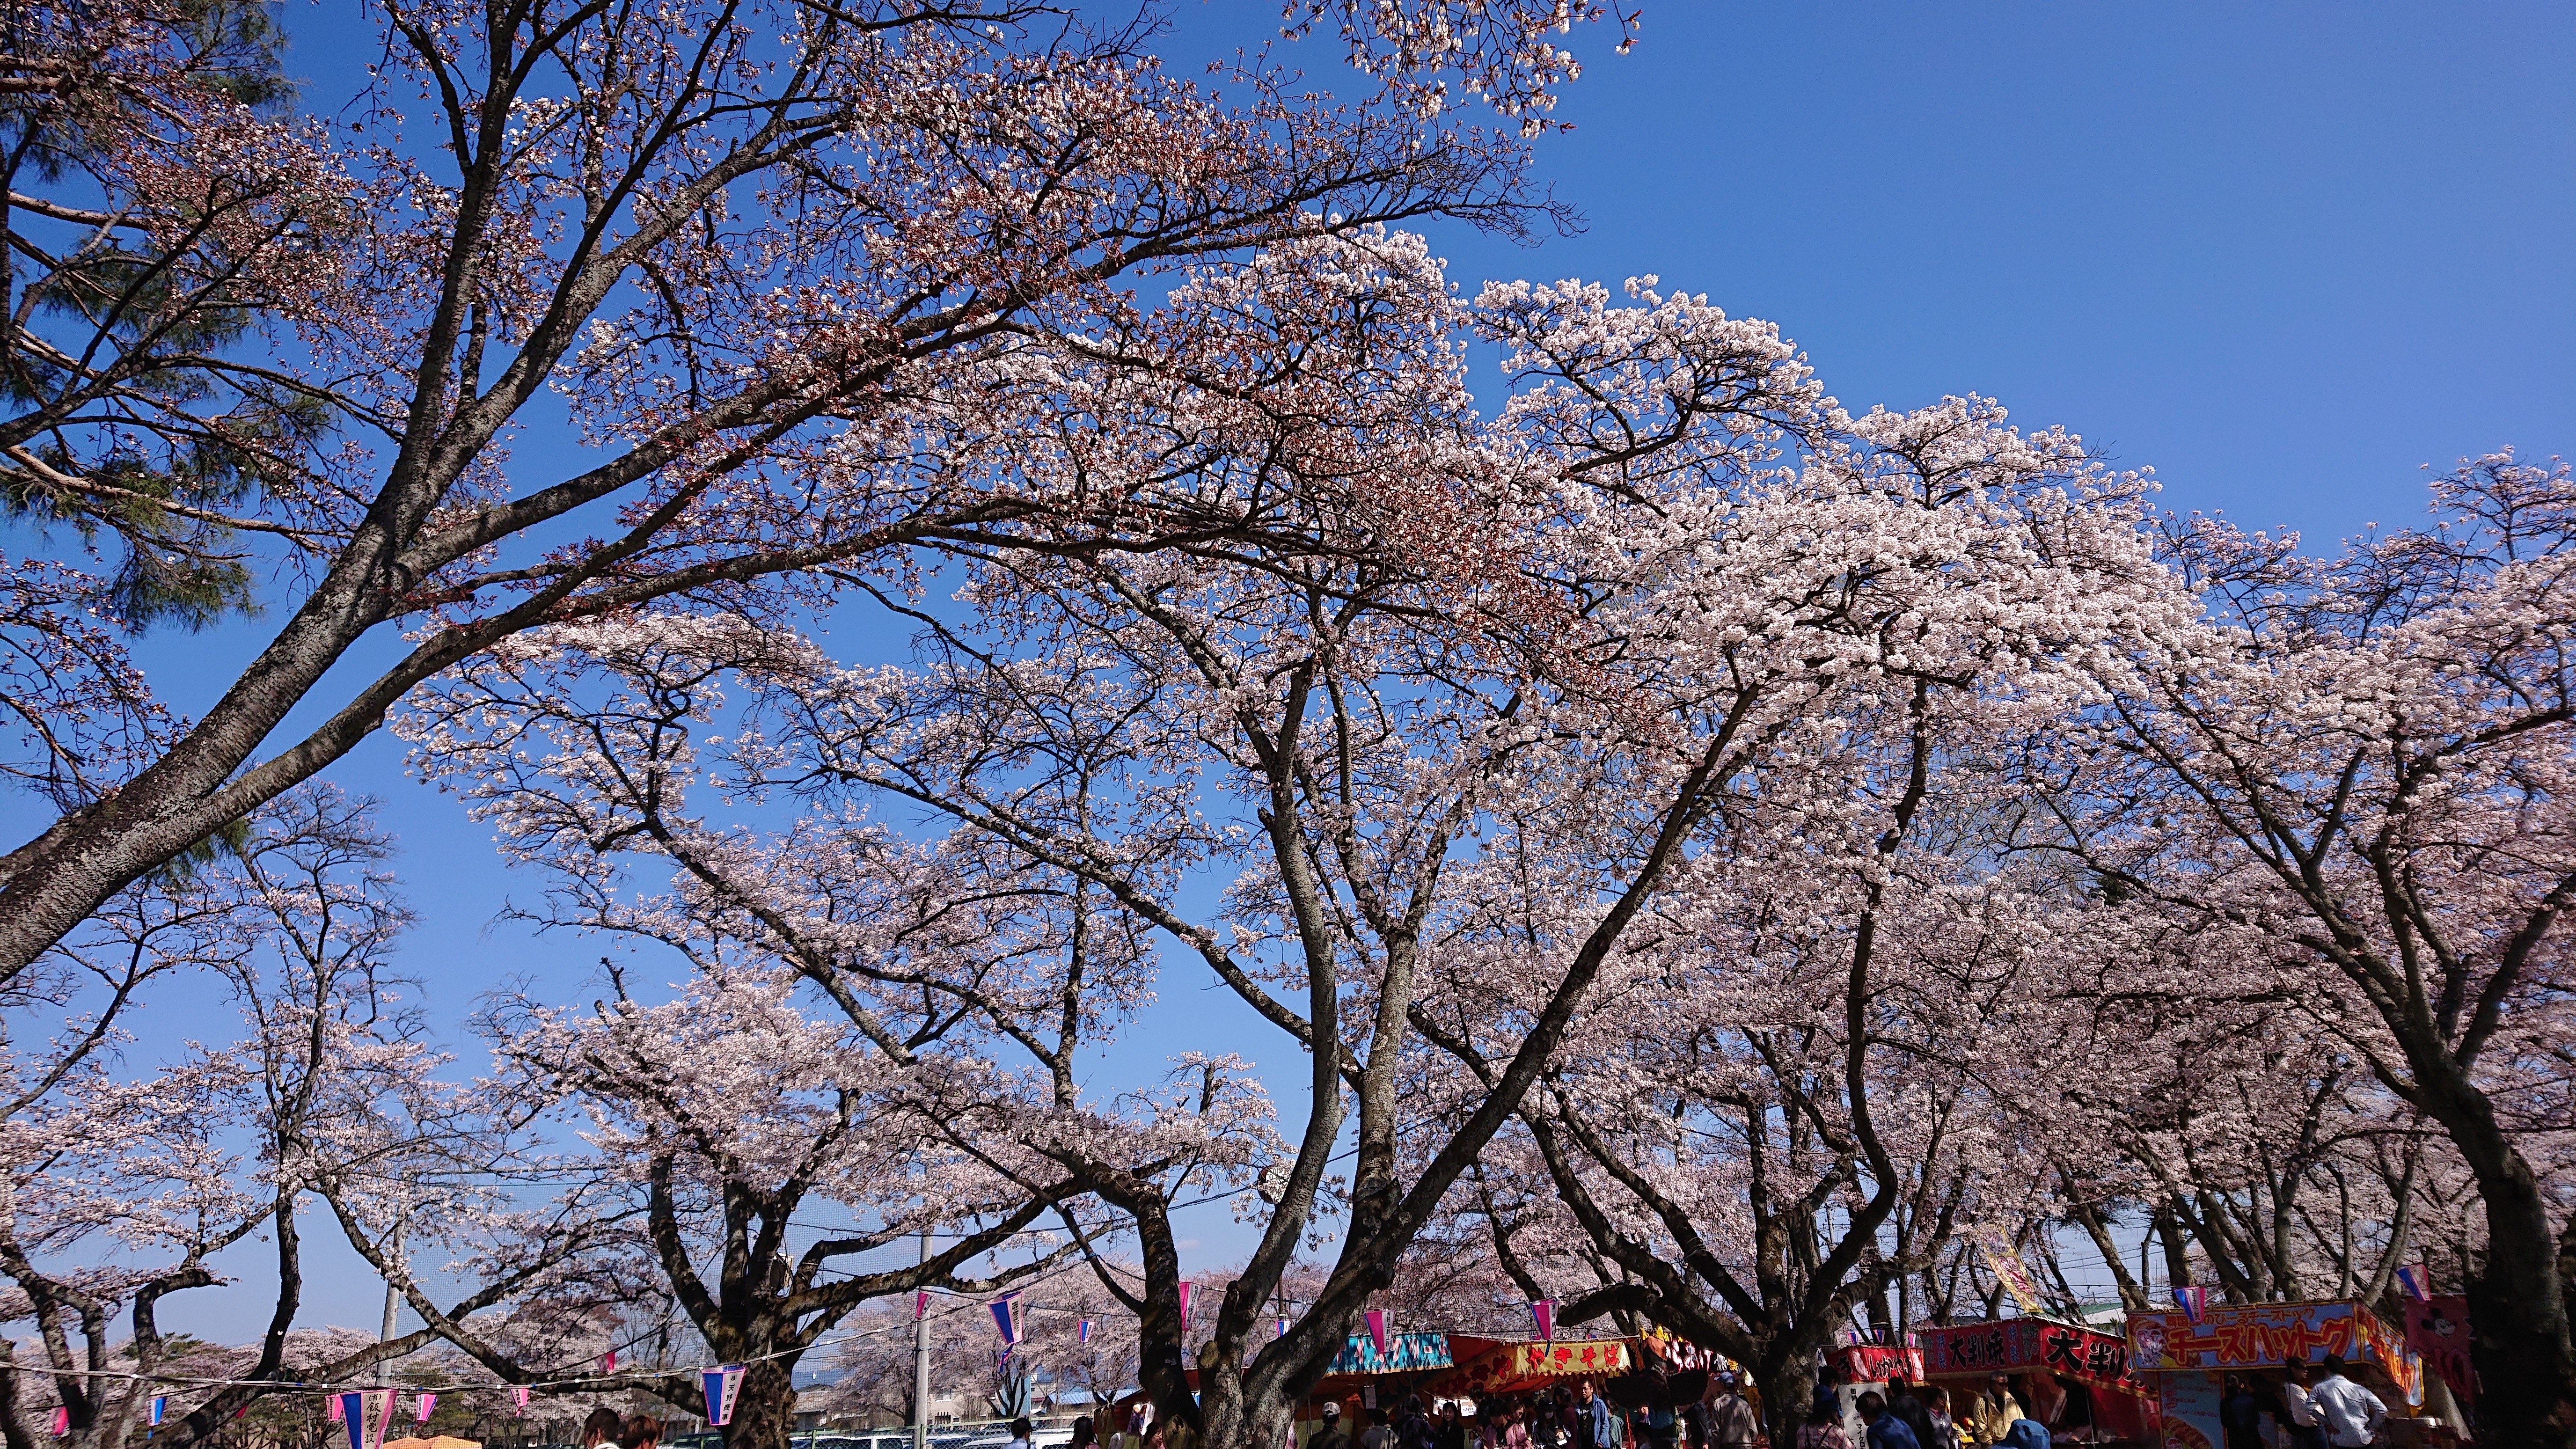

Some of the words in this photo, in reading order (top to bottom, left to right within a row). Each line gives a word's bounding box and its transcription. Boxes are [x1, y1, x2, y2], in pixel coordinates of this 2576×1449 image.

[1525, 1344, 1620, 1371] やきそば
[1949, 1327, 2005, 1369] 大判焼
[2046, 1329, 2145, 1388] 大判
[1856, 1424, 1865, 1449] マイクロ
